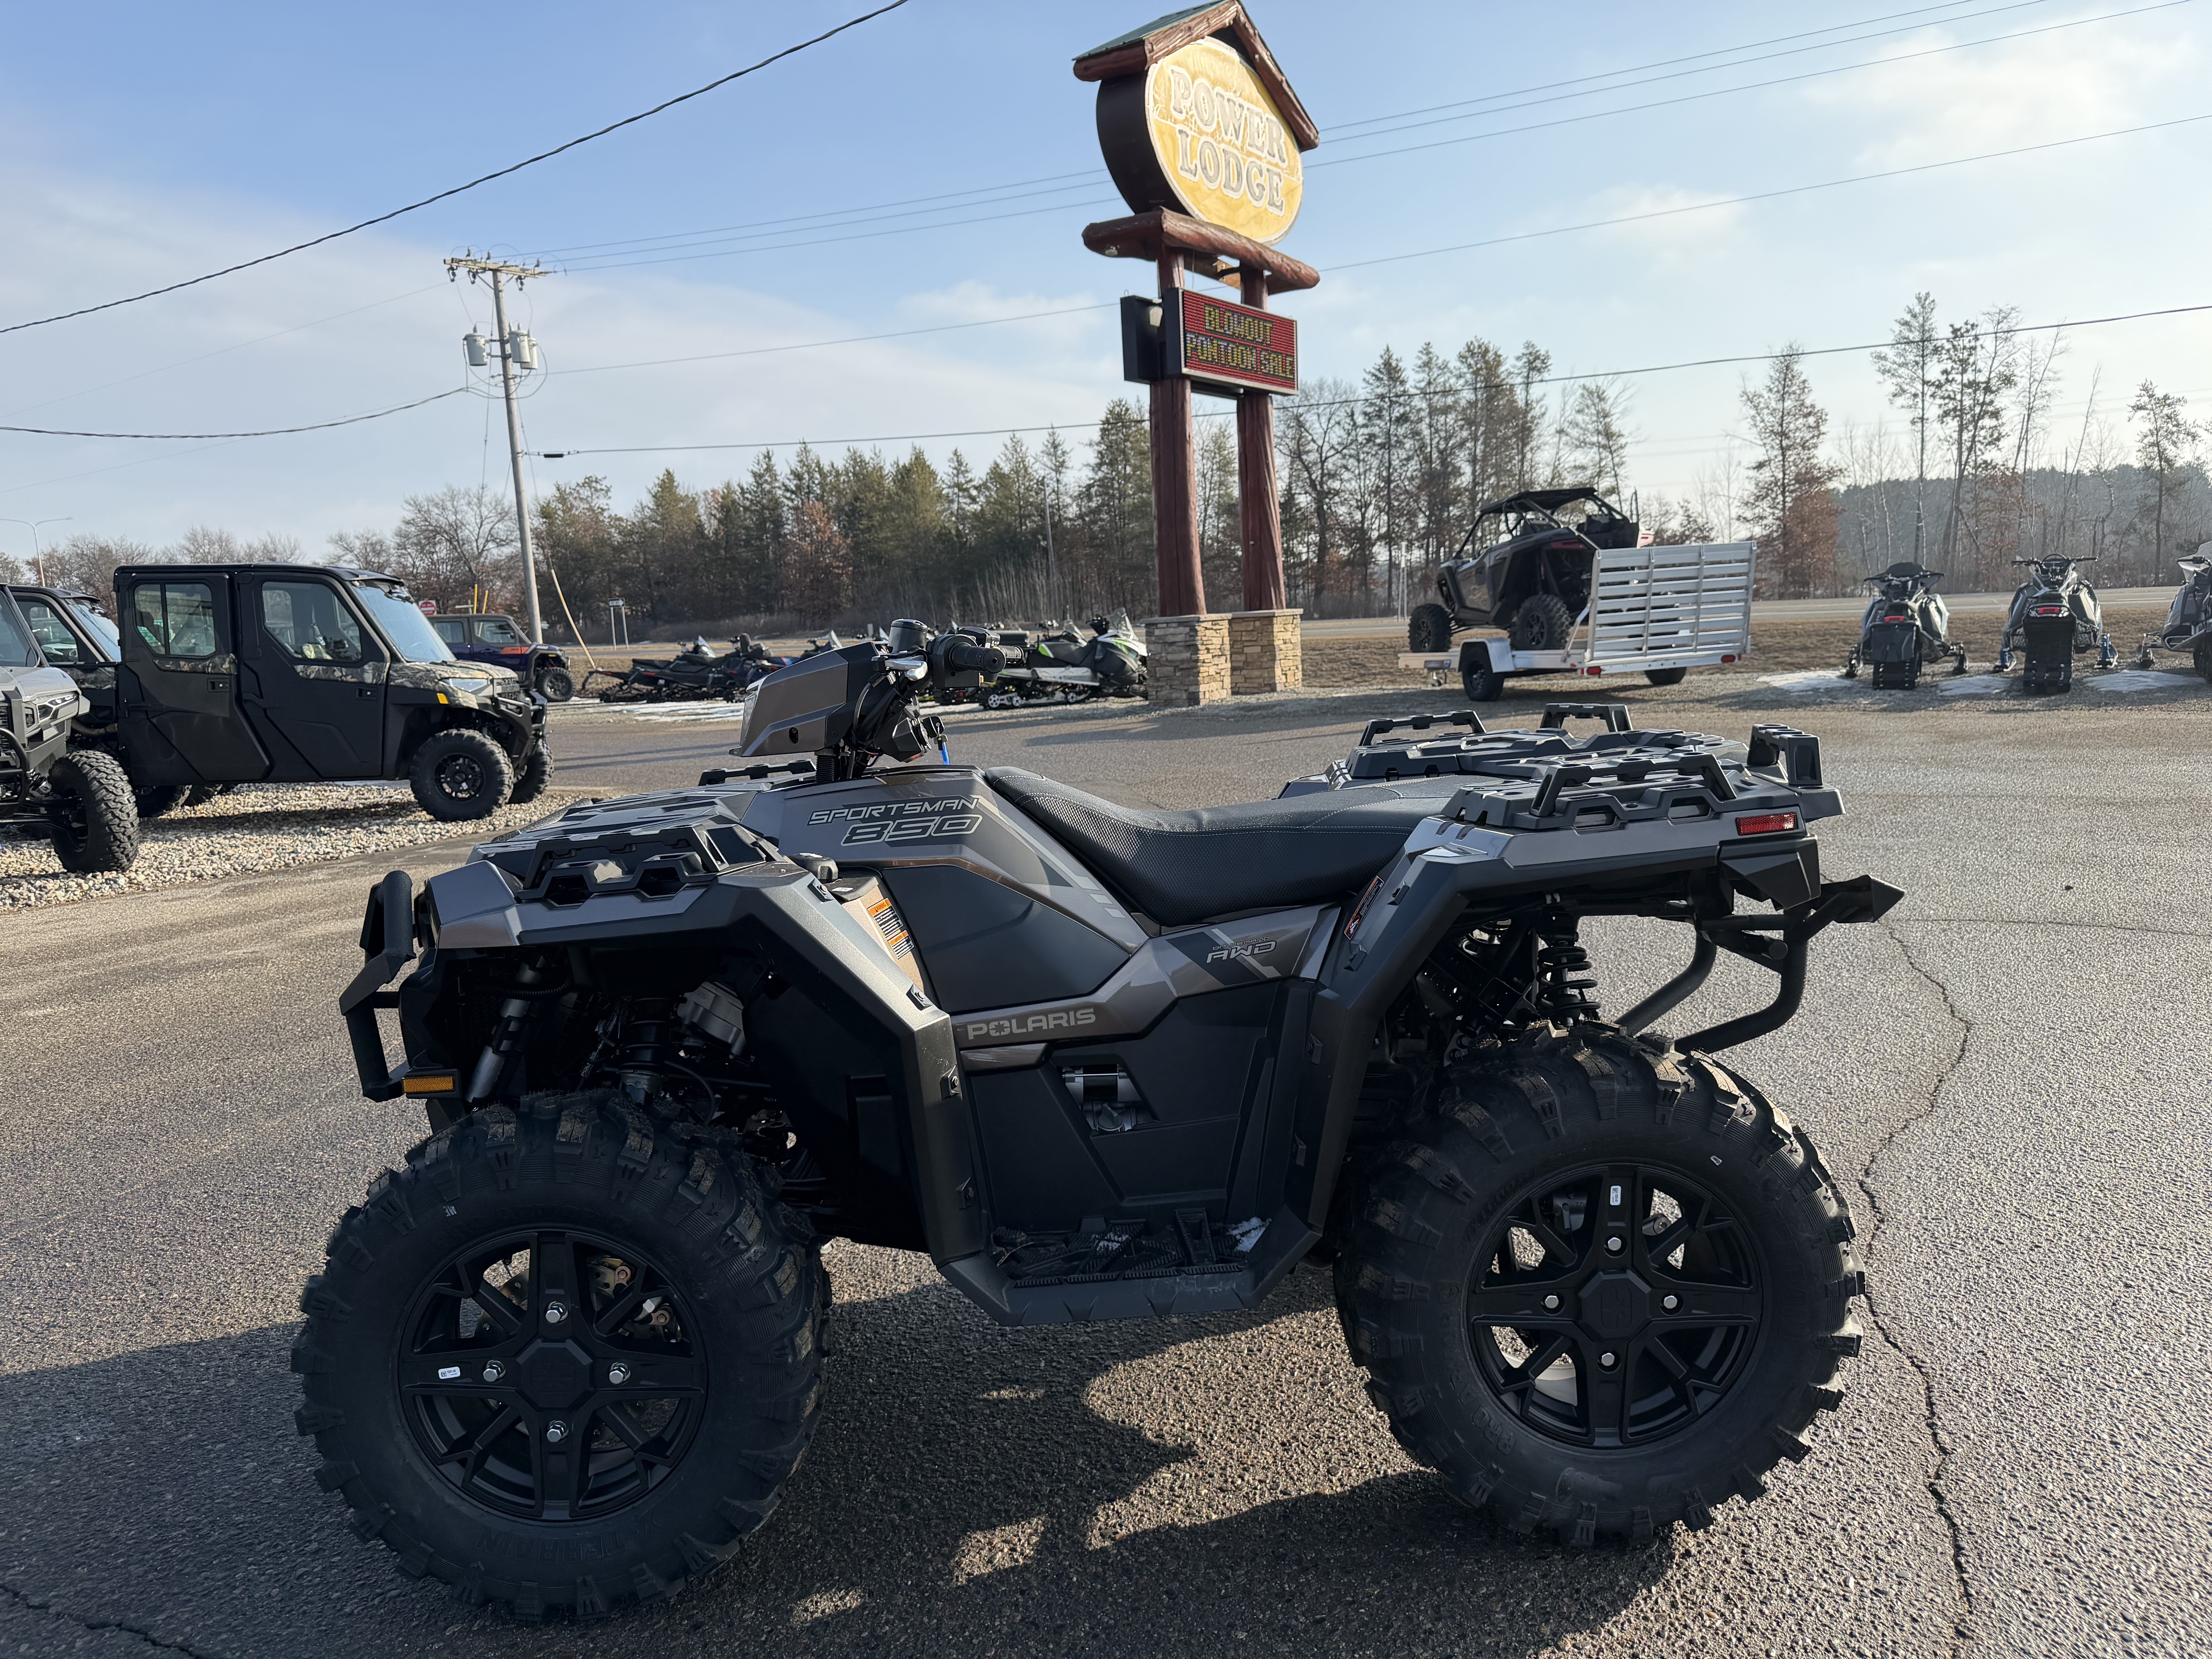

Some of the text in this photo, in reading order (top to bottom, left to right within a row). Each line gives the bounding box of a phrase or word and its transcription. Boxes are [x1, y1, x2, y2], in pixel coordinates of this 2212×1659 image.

[1170, 67, 1288, 167] POWER
[1176, 124, 1285, 216] LODGE
[1205, 305, 1273, 347] BLOWOUT
[1186, 333, 1295, 378] PONTOON SALE
[809, 799, 979, 824] SPORTSMAN
[841, 814, 983, 846] 850
[1206, 941, 1277, 963] AWD
[967, 1008, 1096, 1040] POLARIS
[1470, 1407, 1518, 1455] PRO
